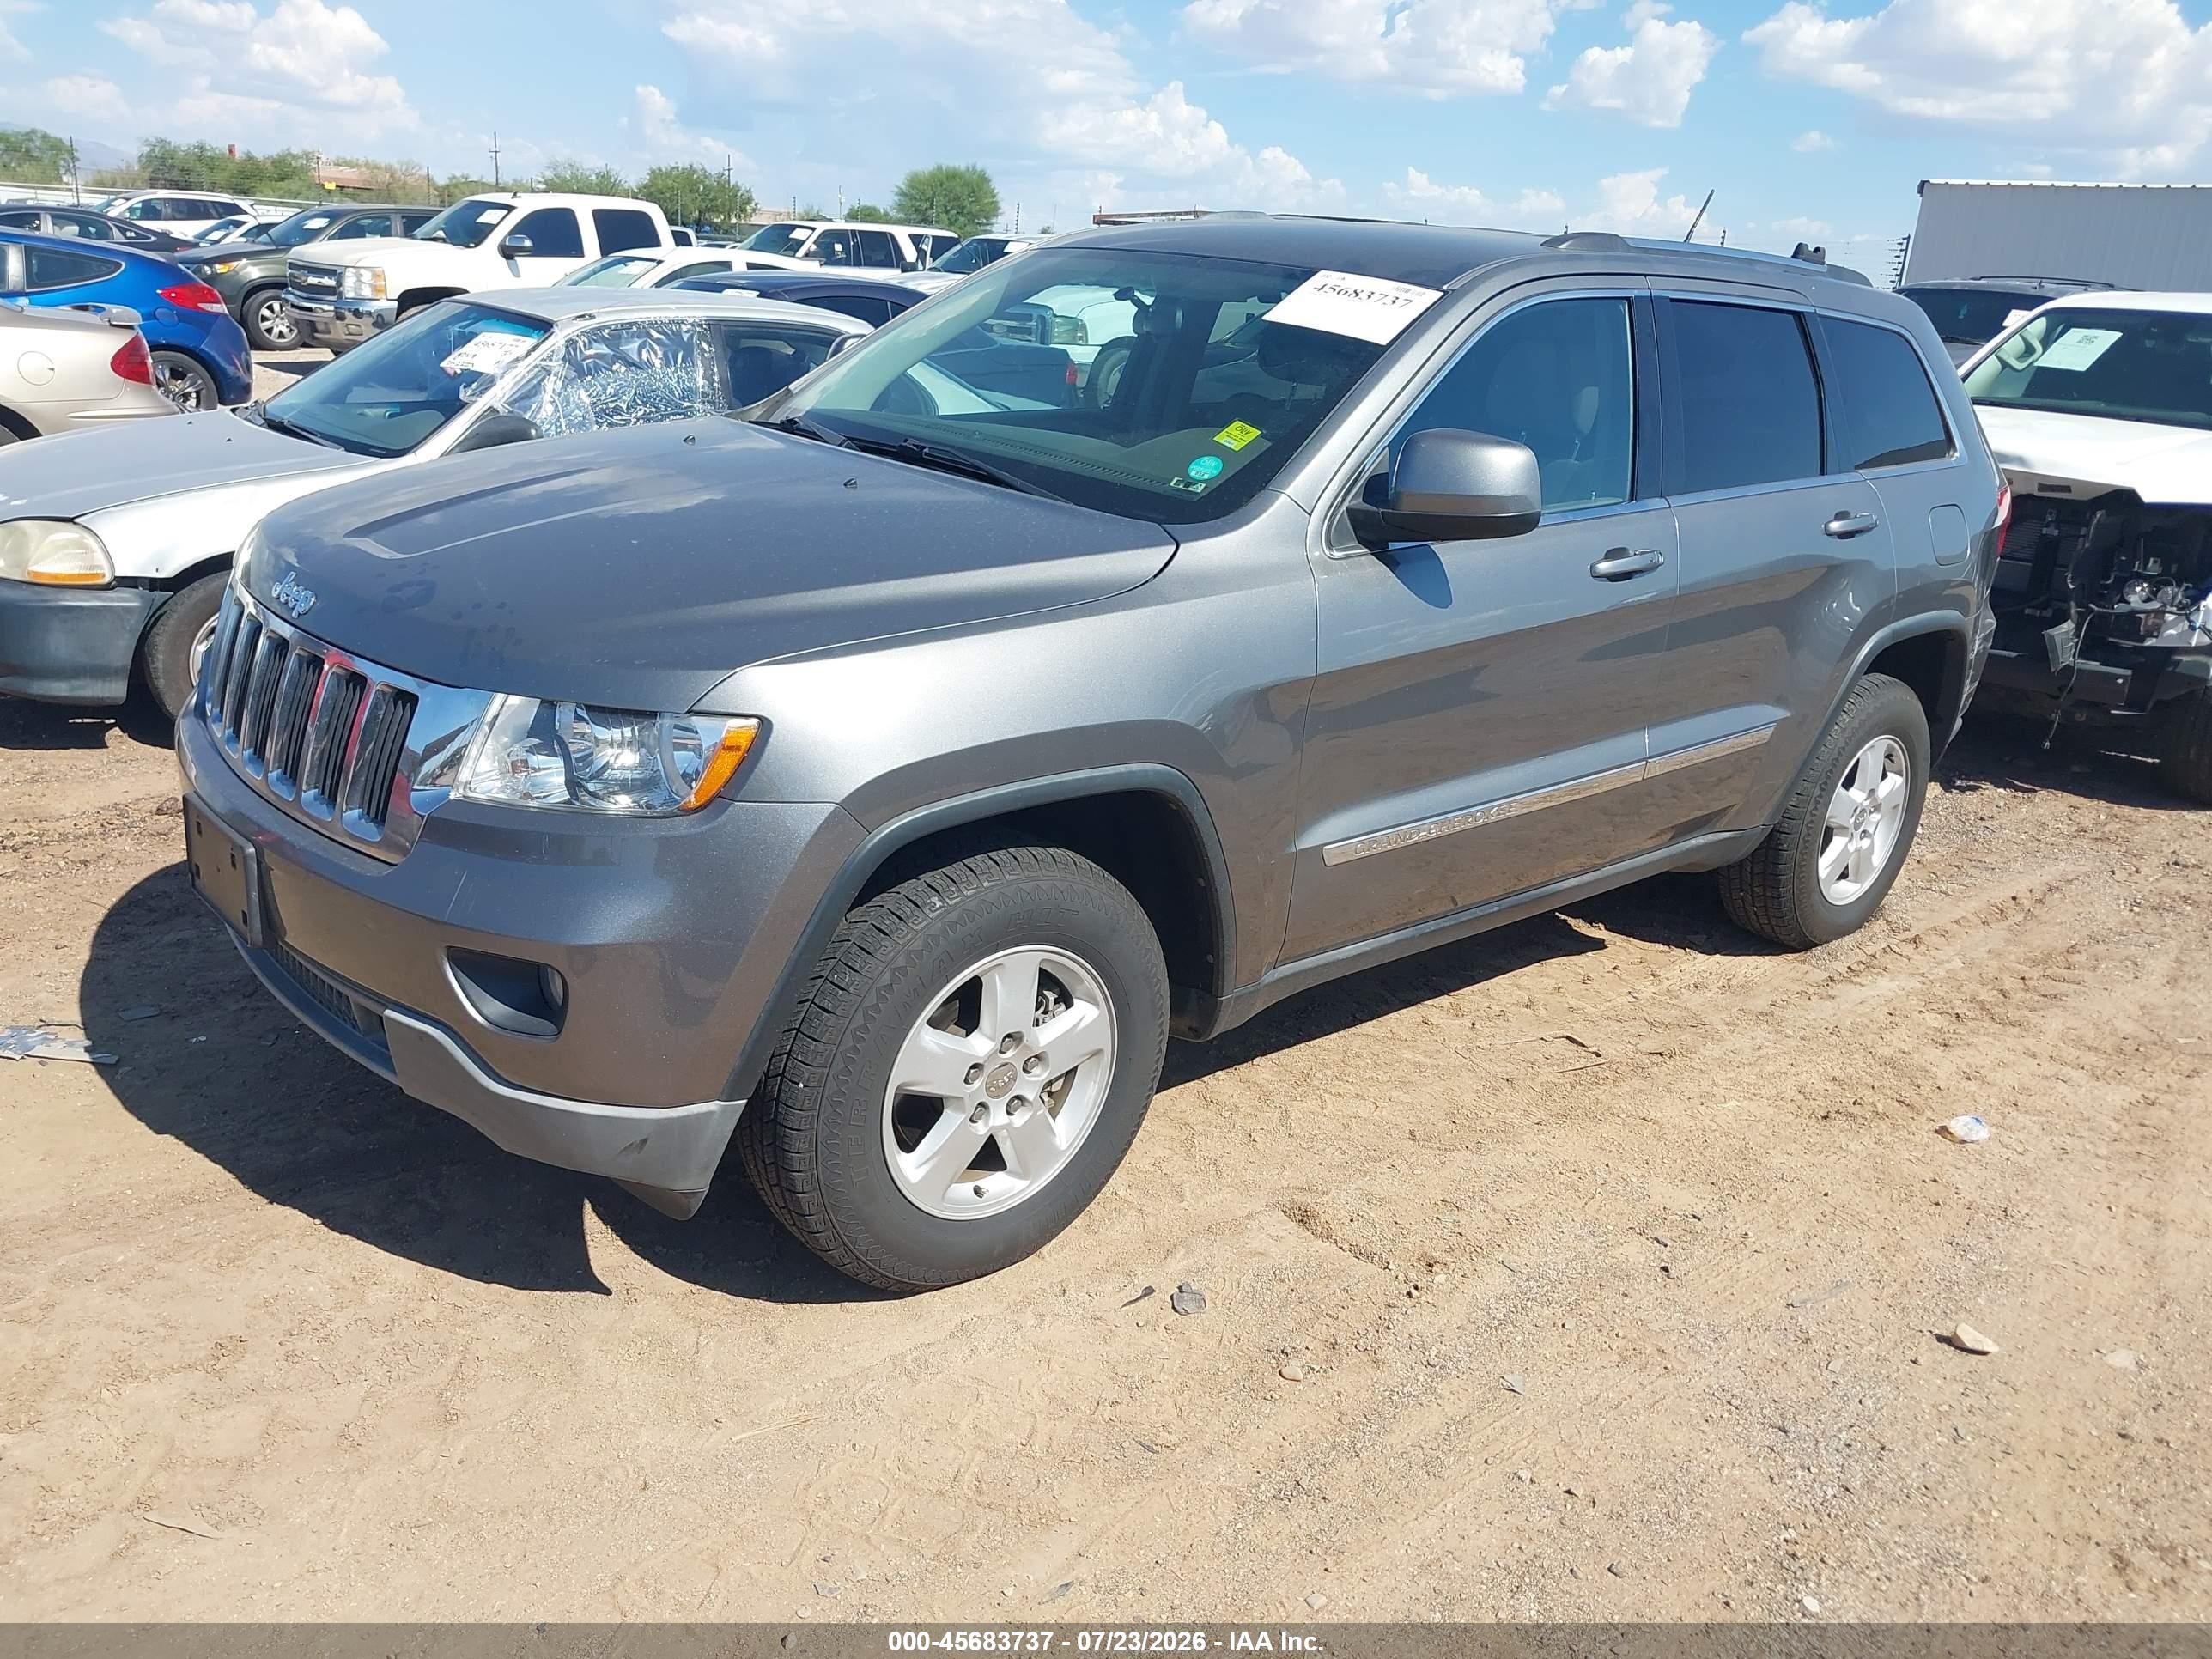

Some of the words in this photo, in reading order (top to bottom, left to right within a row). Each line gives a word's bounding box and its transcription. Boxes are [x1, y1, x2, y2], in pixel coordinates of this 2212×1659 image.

[1313, 283, 1414, 309] 45683737
[271, 571, 317, 619] Jeep
[1352, 829, 1422, 857] GRAND
[1427, 802, 1520, 836] CHEROKEE
